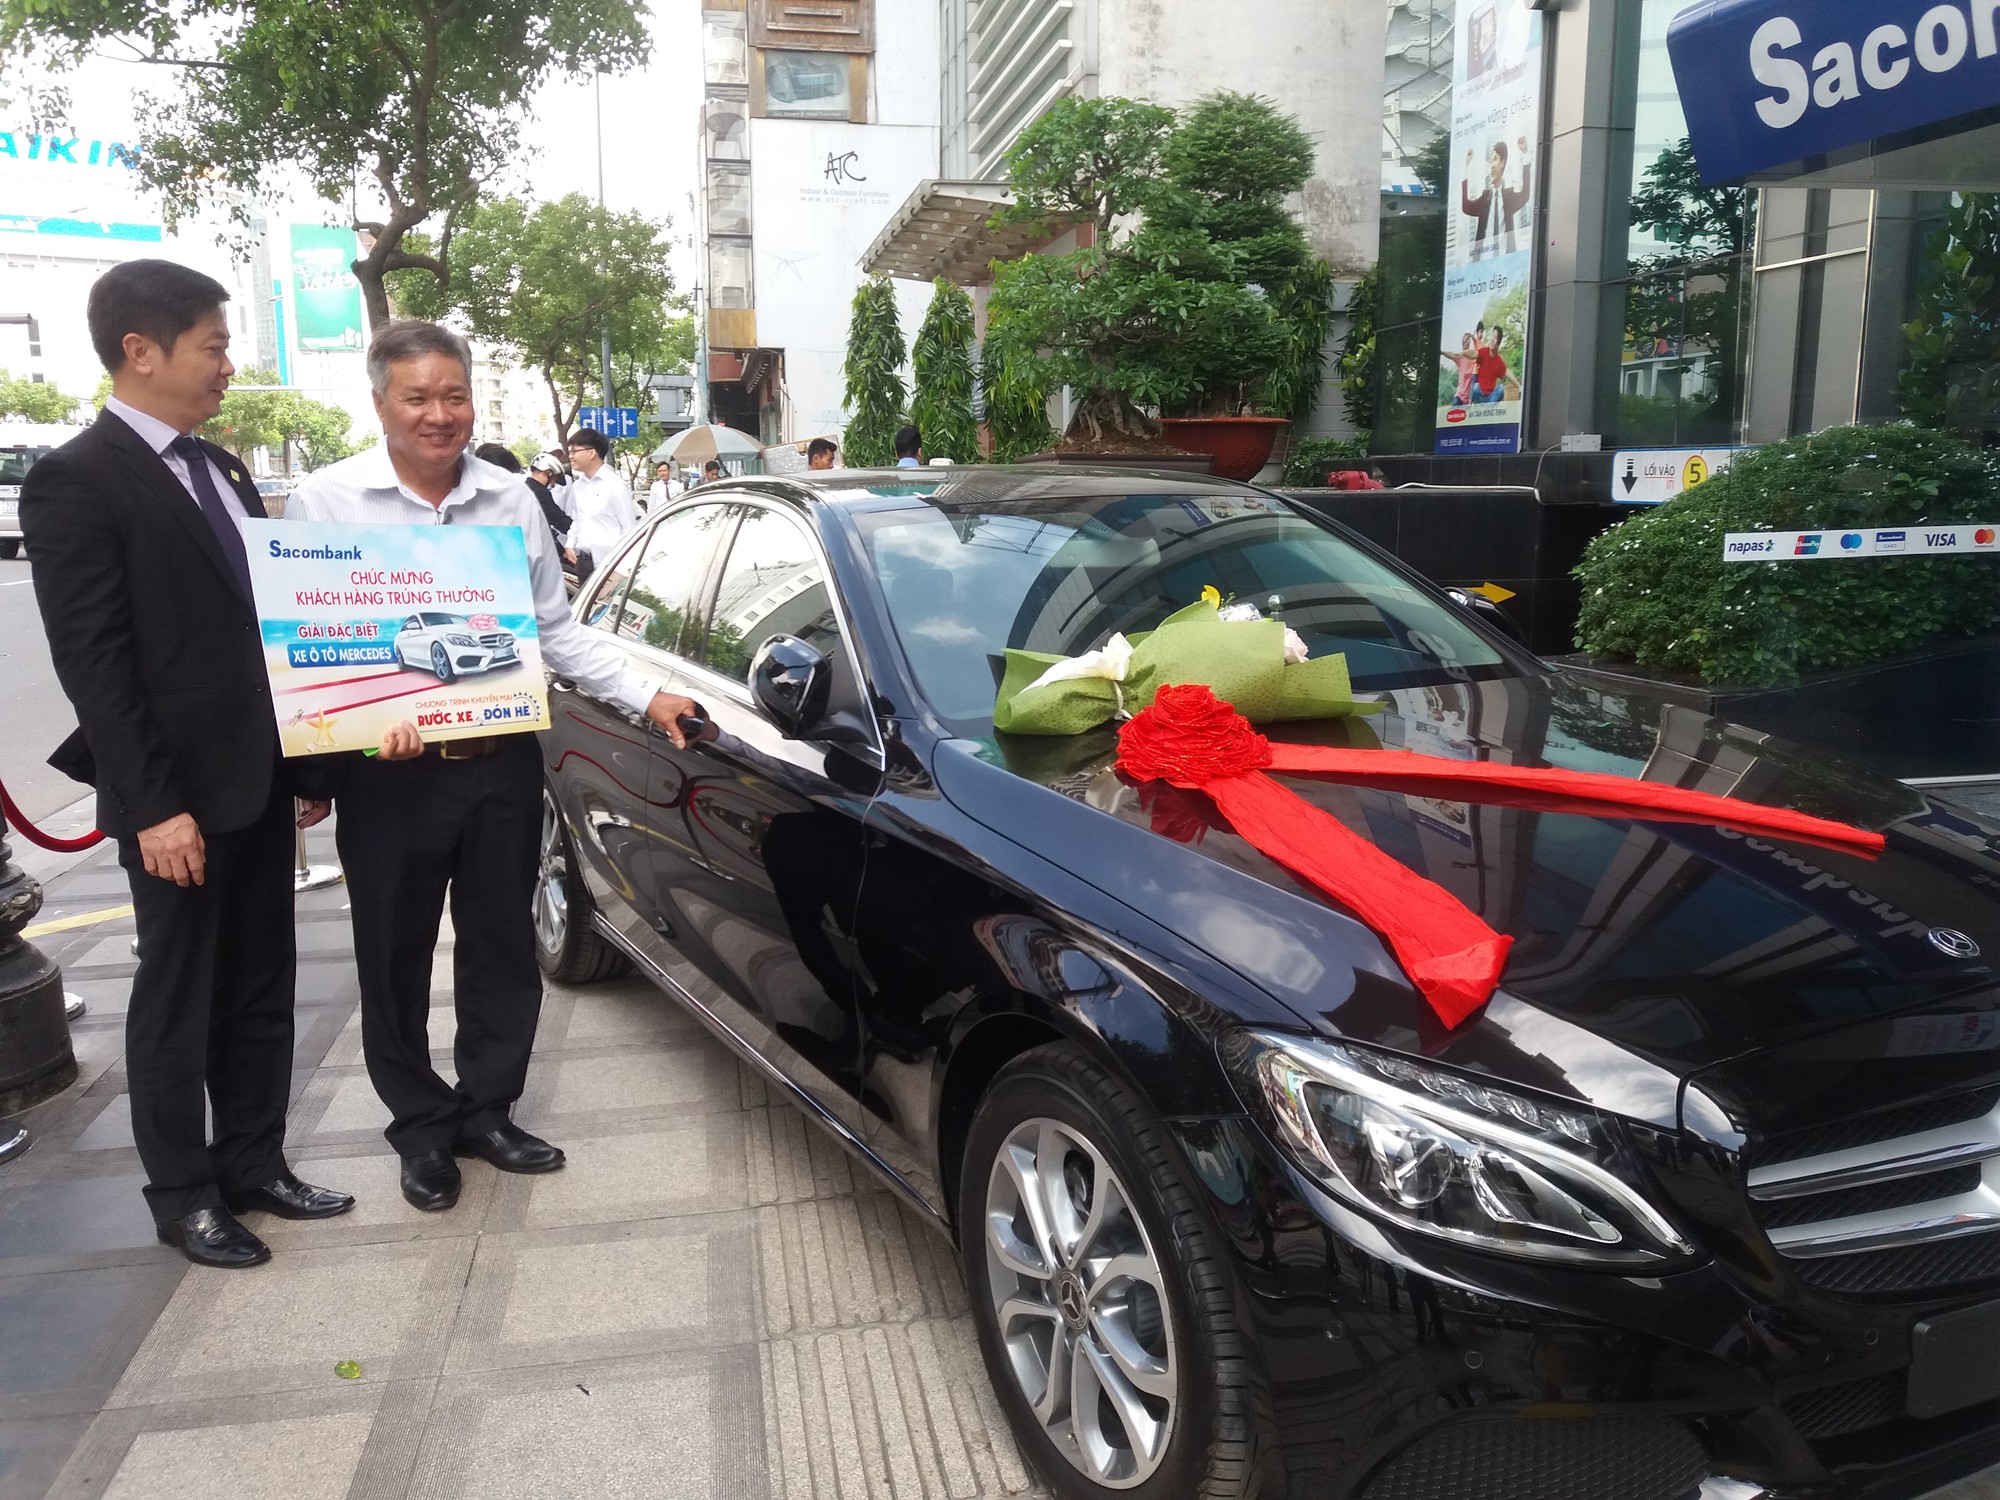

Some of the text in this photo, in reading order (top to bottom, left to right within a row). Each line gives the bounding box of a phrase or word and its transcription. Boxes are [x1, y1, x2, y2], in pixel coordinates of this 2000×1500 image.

[824, 151, 867, 185] ATC
[1644, 463, 1657, 476] LỐI
[1659, 463, 1675, 476] VÀO
[1689, 463, 1701, 484] 5
[1728, 541, 1765, 555] napas
[1924, 533, 1957, 547] VISA
[269, 539, 362, 560] Sacombank
[351, 568, 434, 585] CHÚC MỪNG
[295, 588, 341, 605] KHÁCH
[344, 588, 384, 605] HÀNG
[386, 588, 433, 605] TRÚNG
[298, 622, 378, 641] GIẢI ĐẶC BIỆT
[293, 645, 392, 663] XE Ô TÔ MERCEDES
[417, 701, 531, 727] RƯỚC XE ĐÓN HÈ
